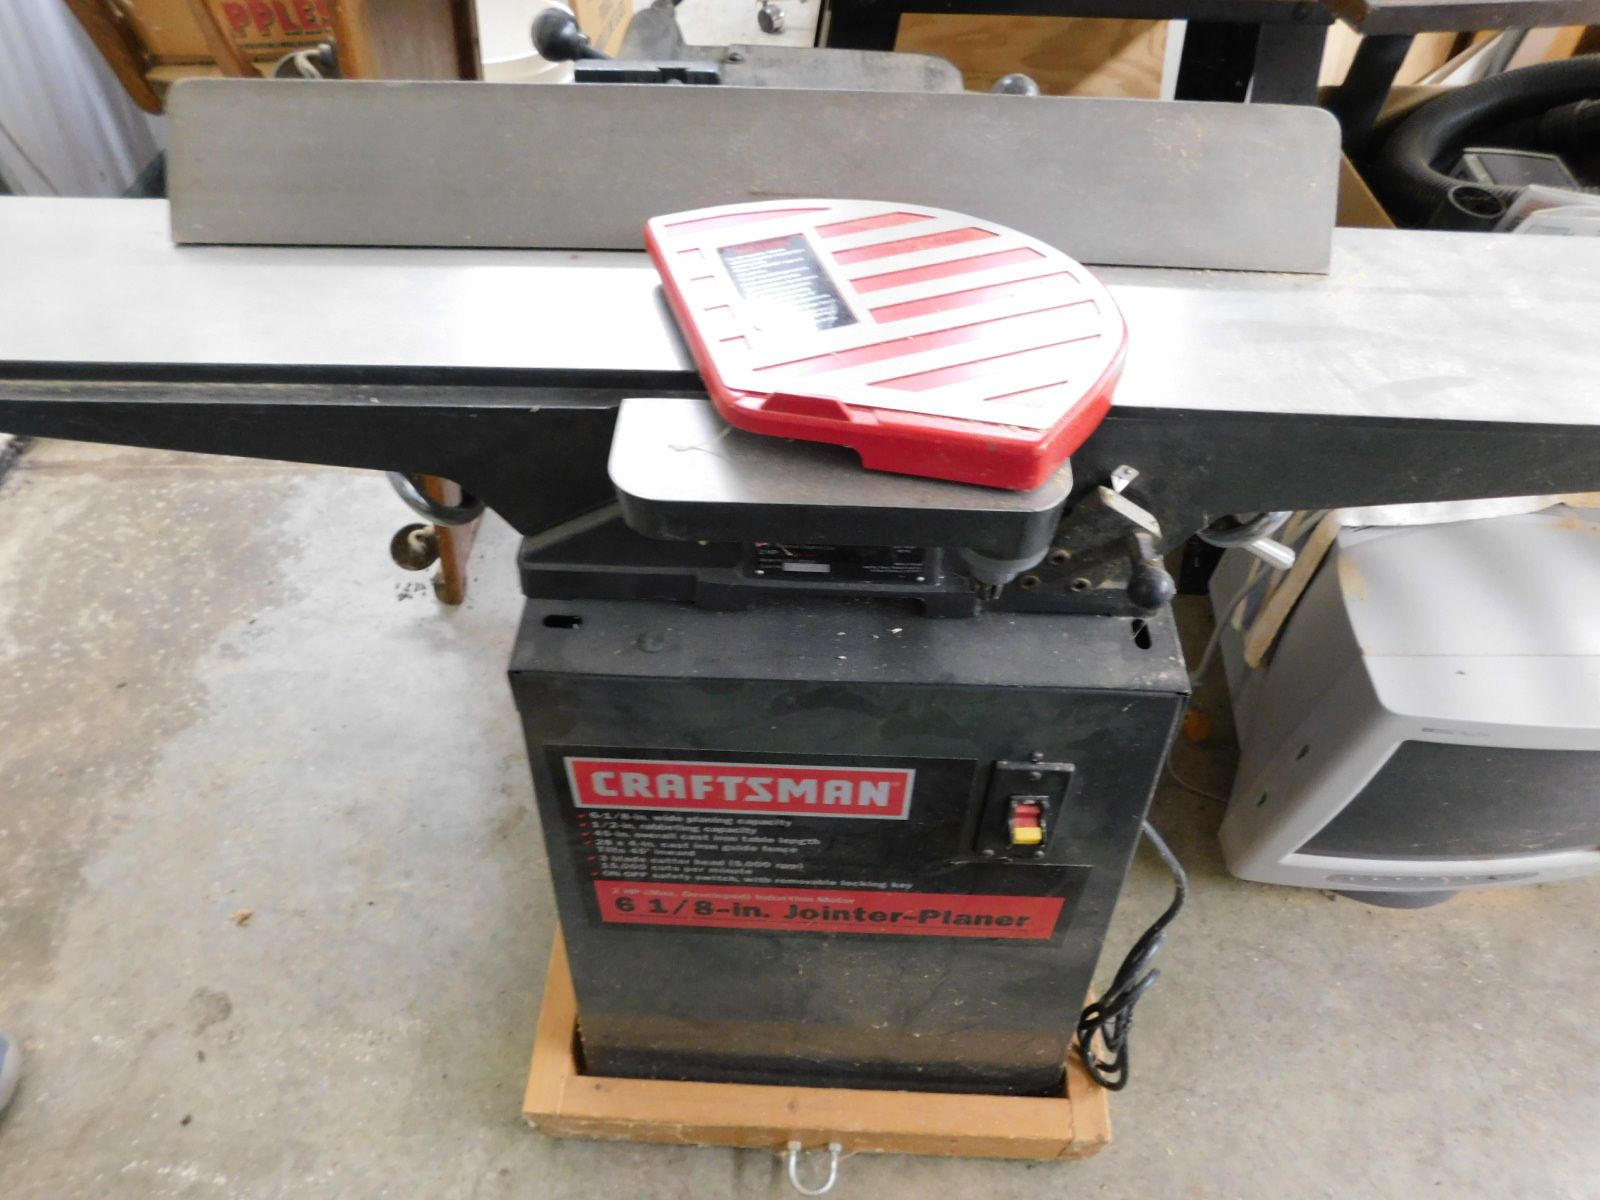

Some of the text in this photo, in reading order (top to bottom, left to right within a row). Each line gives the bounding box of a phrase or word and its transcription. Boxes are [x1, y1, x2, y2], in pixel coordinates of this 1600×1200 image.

[590, 771, 890, 806] CRAFTSMAN
[736, 818, 792, 827] capacity
[703, 826, 757, 835] capacity
[778, 838, 821, 846] length
[774, 878, 837, 886] removable
[840, 880, 887, 889] locking
[891, 882, 913, 890] key
[614, 897, 1030, 928] 6 1/8-in. Jointer-Planer
